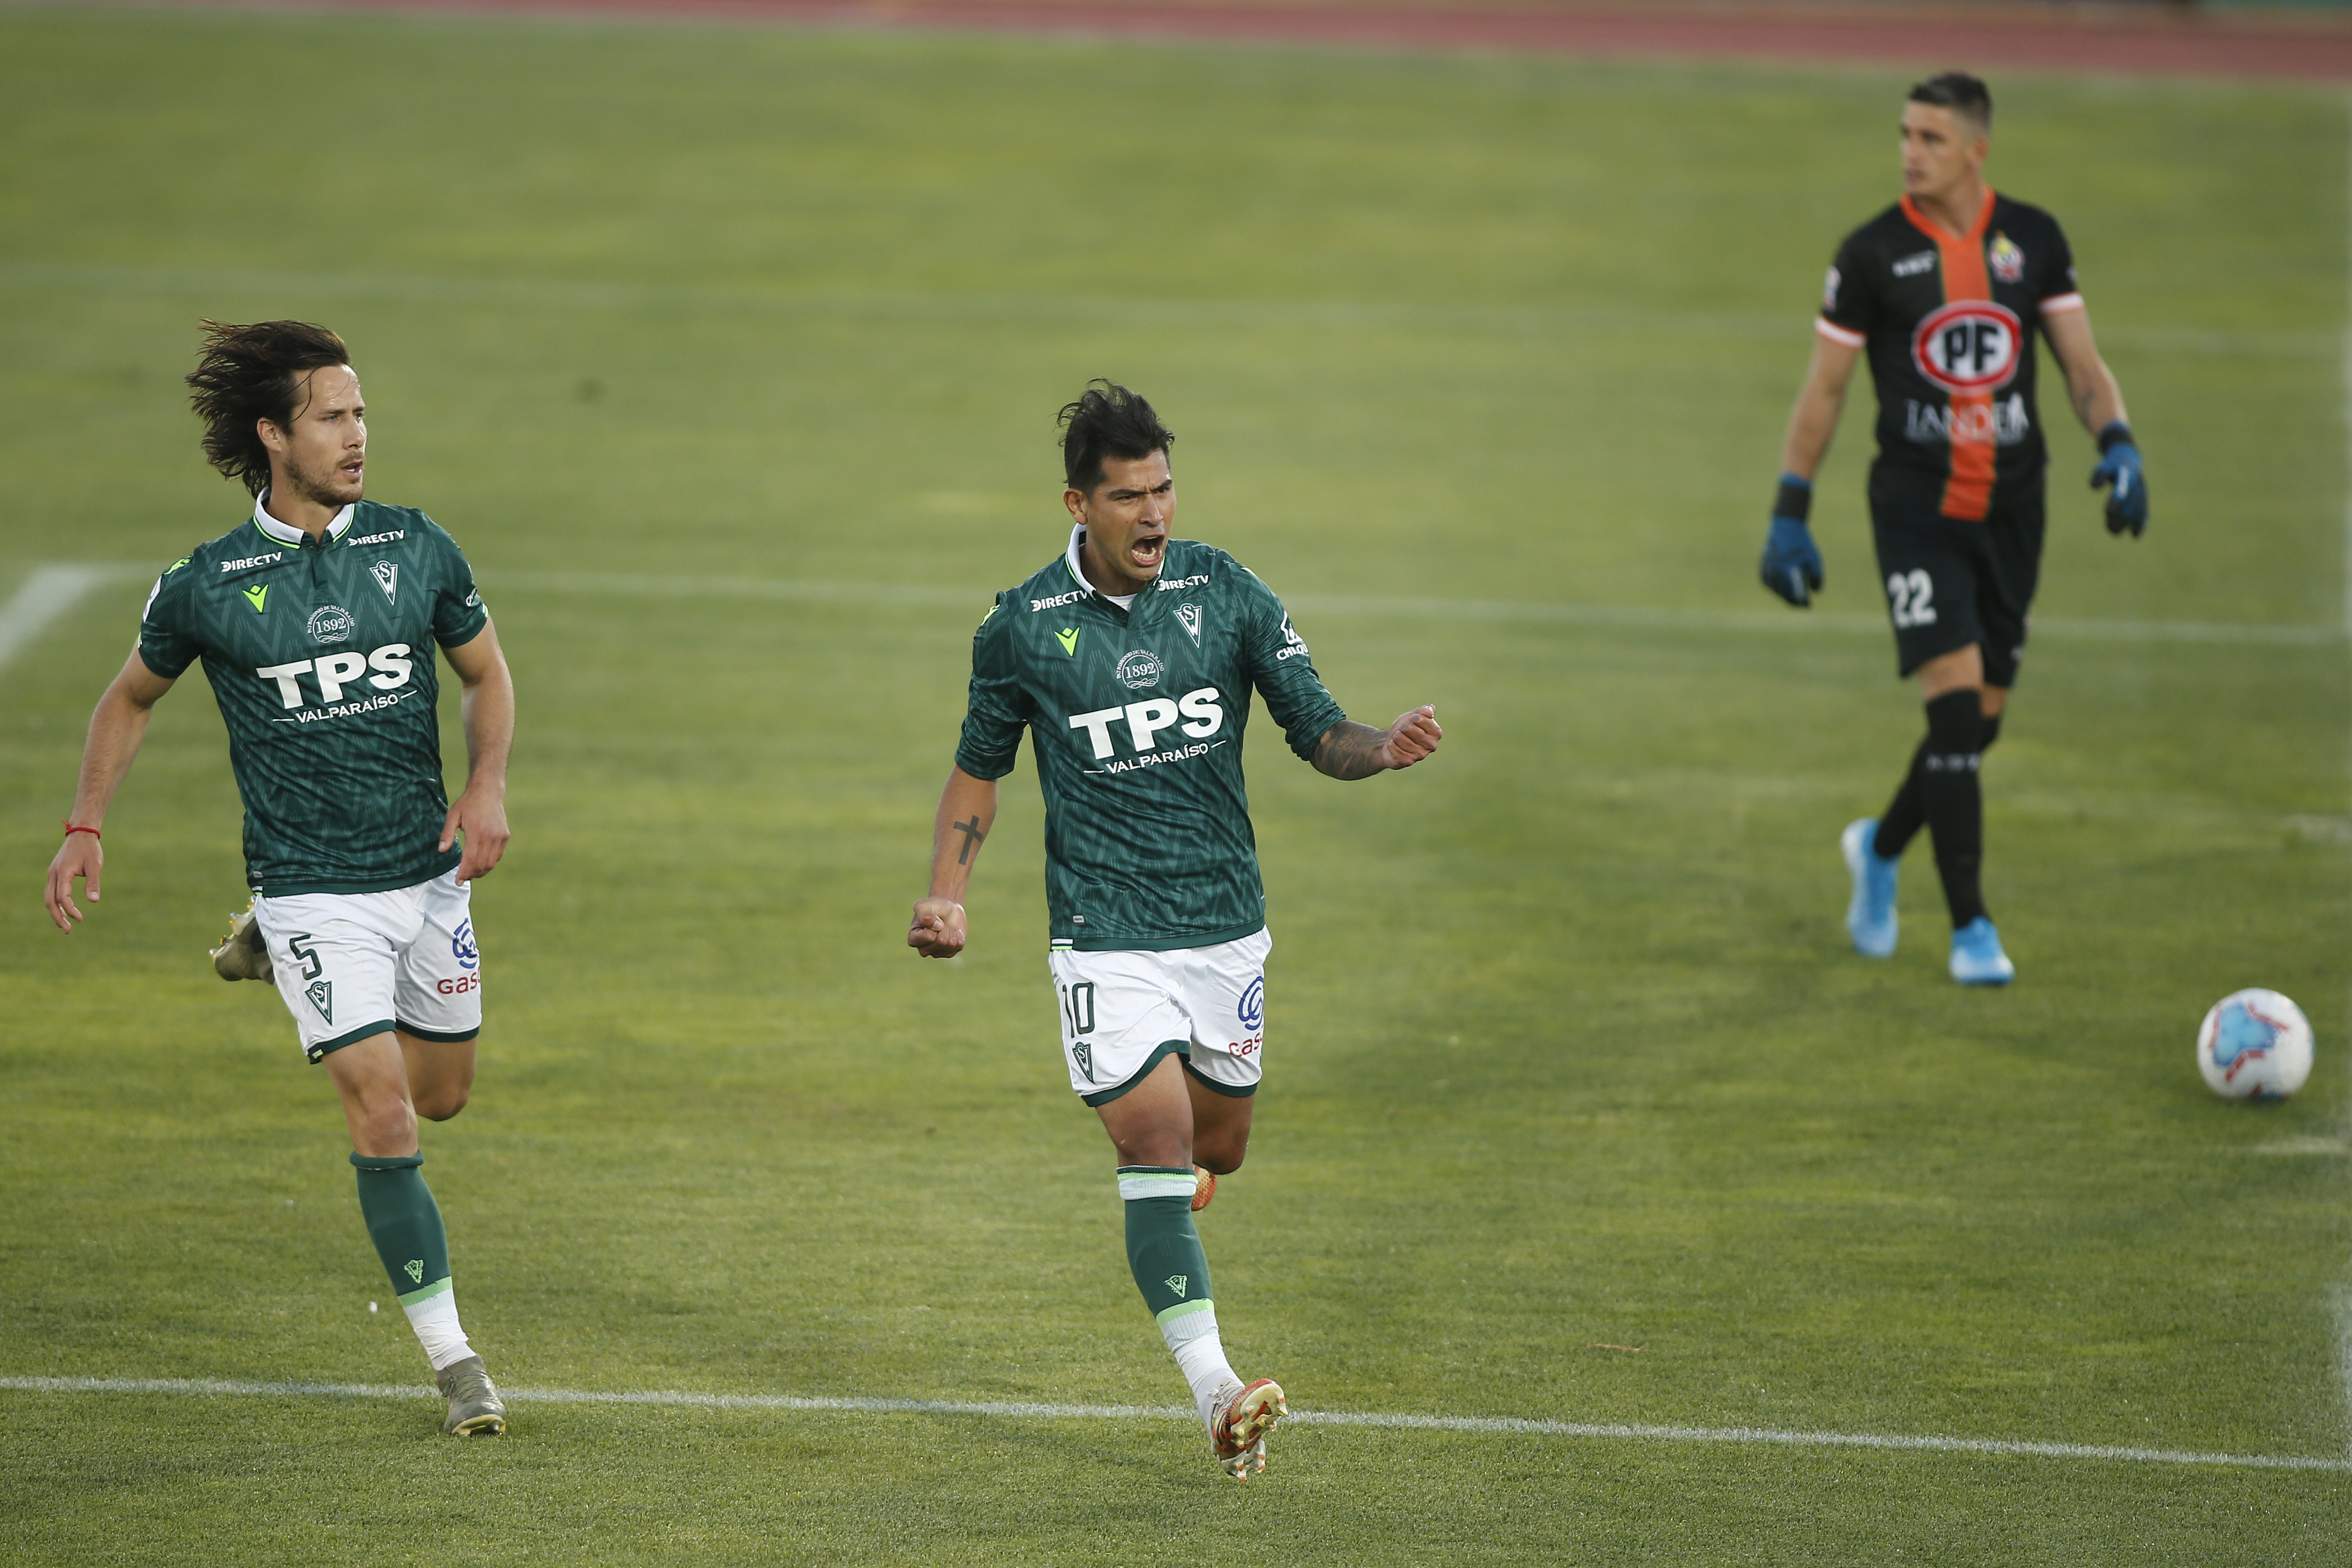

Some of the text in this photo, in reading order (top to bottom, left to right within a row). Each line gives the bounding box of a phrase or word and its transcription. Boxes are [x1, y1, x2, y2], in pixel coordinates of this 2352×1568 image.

[1944, 323, 1998, 371] PF
[348, 529, 405, 546] DIRECTV
[221, 552, 282, 572] DIRECTV
[1158, 575, 1209, 591] DIRECTV
[1887, 567, 1937, 628] 22
[1030, 589, 1088, 612] DIRECTV
[307, 607, 324, 633] PATRIMONIO
[315, 618, 347, 633] 1892
[256, 643, 413, 709] TPS
[1116, 652, 1133, 679] PATRIMONIO
[1125, 662, 1156, 679] 1892
[295, 693, 399, 724] VALPARAÍSO
[1068, 687, 1224, 760] TPS
[1106, 743, 1209, 774] VALPARAÍSO
[289, 934, 323, 981] 5
[1062, 982, 1095, 1039] 10
